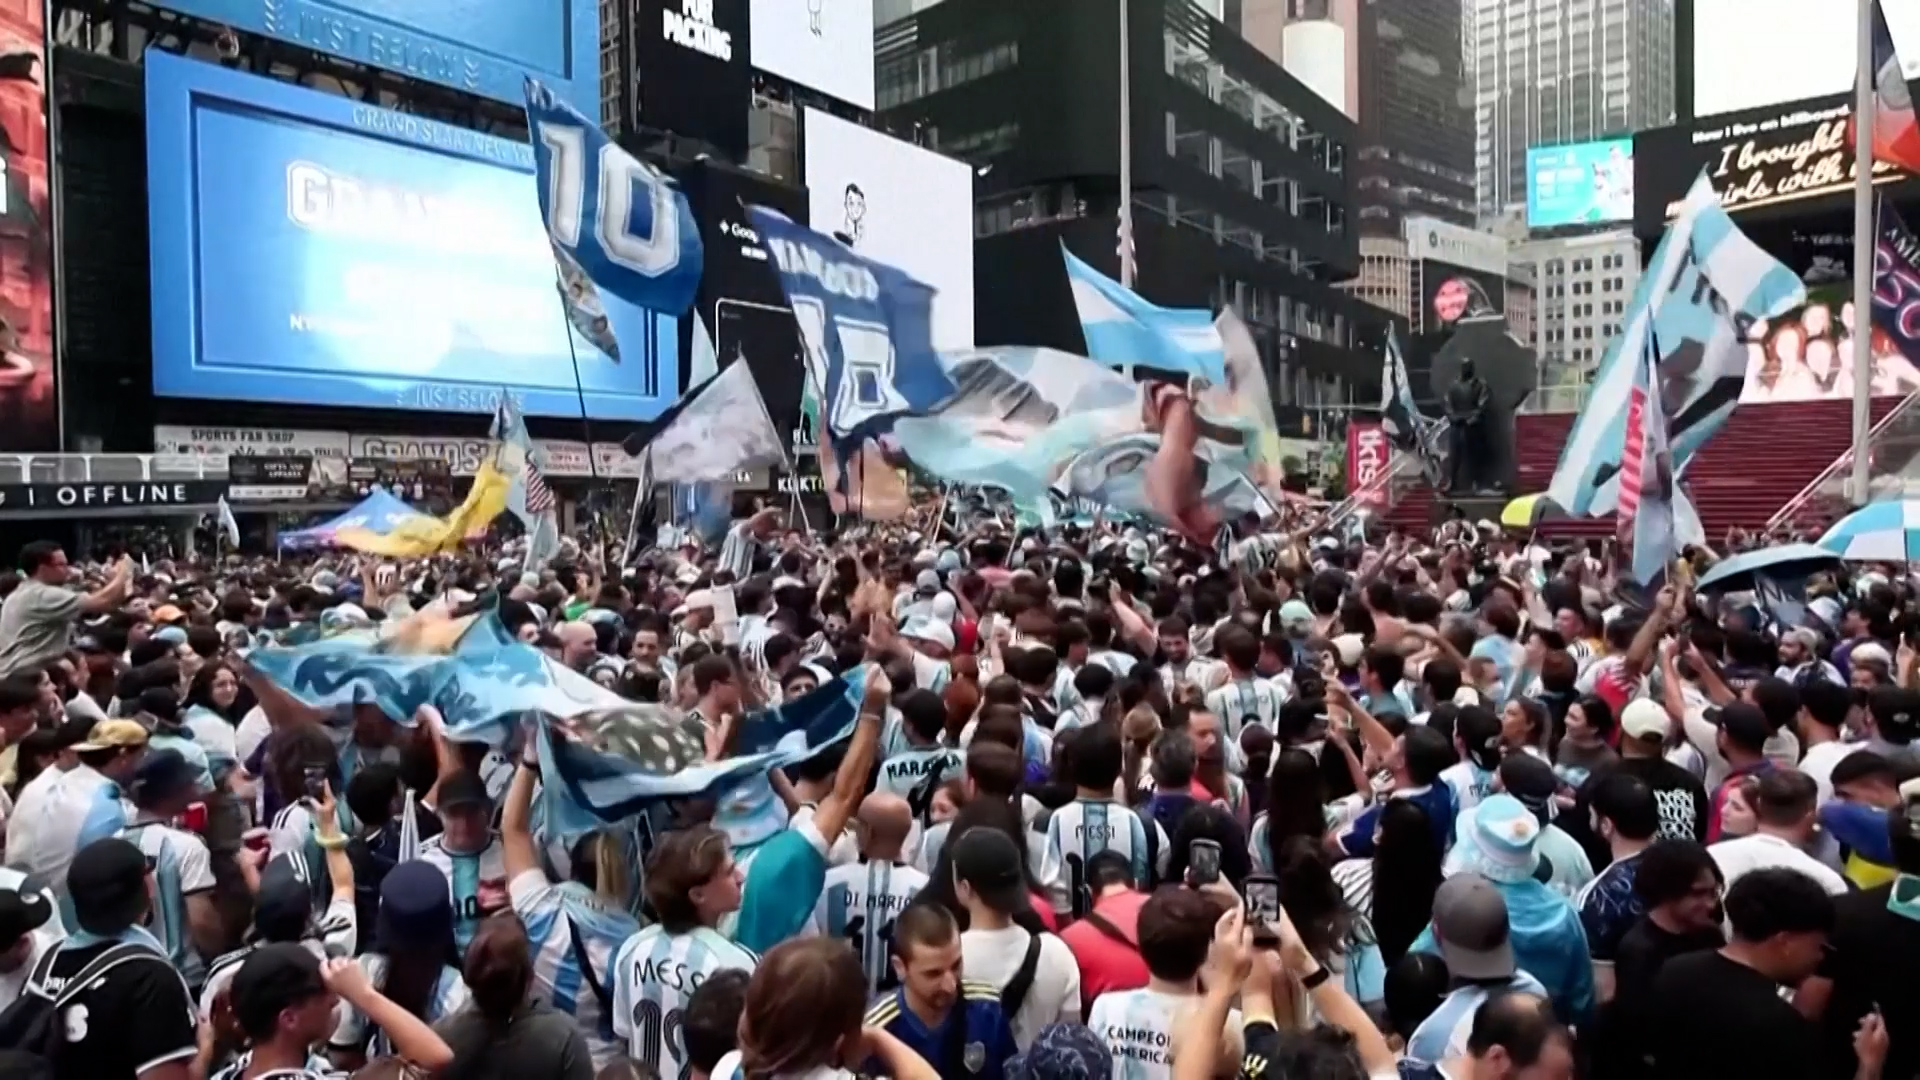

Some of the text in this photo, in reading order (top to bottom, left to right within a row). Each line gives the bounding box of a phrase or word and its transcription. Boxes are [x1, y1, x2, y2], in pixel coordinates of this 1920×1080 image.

[663, 8, 732, 62] PACKING
[353, 107, 416, 139] GRAND
[1713, 120, 1847, 178] I brought
[537, 120, 680, 278] 10
[1717, 171, 1774, 206] irls
[1777, 151, 1844, 194] with
[191, 428, 295, 444] SPORTS FAN SHOP
[1358, 428, 1382, 486] tkts
[57, 484, 187, 506] OFFLINE
[1075, 825, 1116, 840] MESSI
[844, 889, 859, 907] DI
[634, 957, 706, 998] MESS
